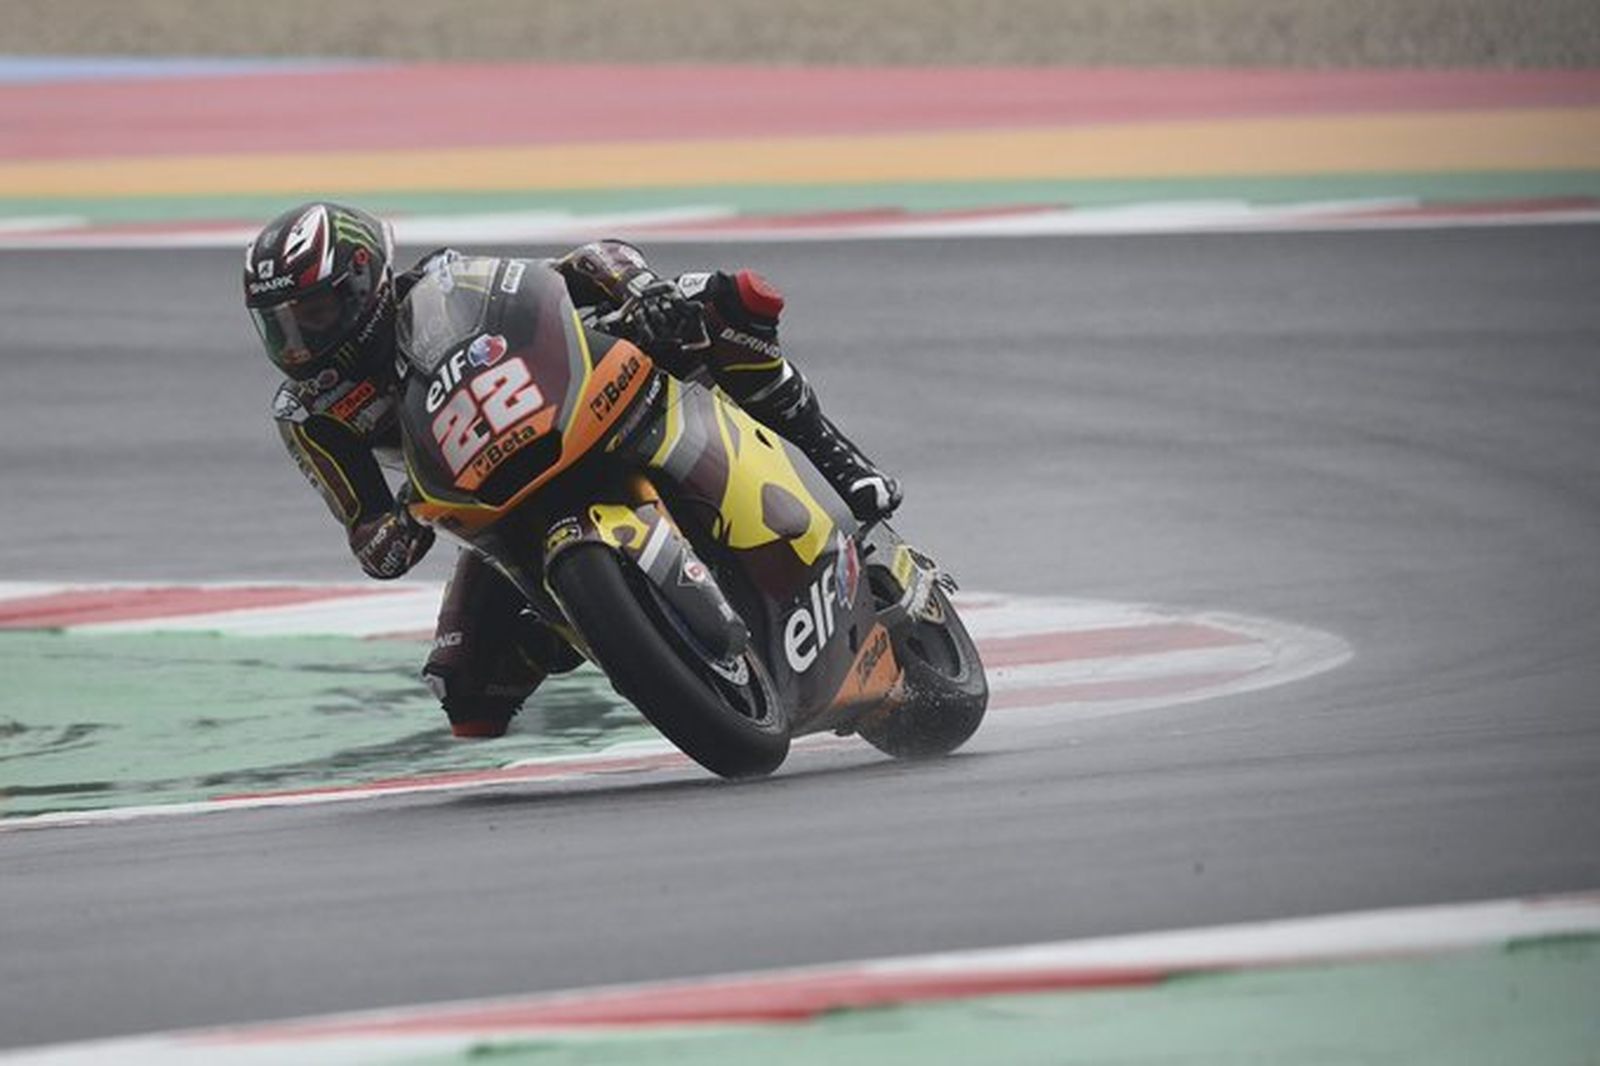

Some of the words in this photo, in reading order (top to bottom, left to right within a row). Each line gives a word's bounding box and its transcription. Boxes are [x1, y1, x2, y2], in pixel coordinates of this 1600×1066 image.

[250, 274, 295, 295] SHARK
[426, 349, 467, 413] elf
[606, 356, 641, 409] Beta
[432, 356, 544, 478] 22
[488, 424, 537, 464] Beta
[784, 563, 837, 673] elf
